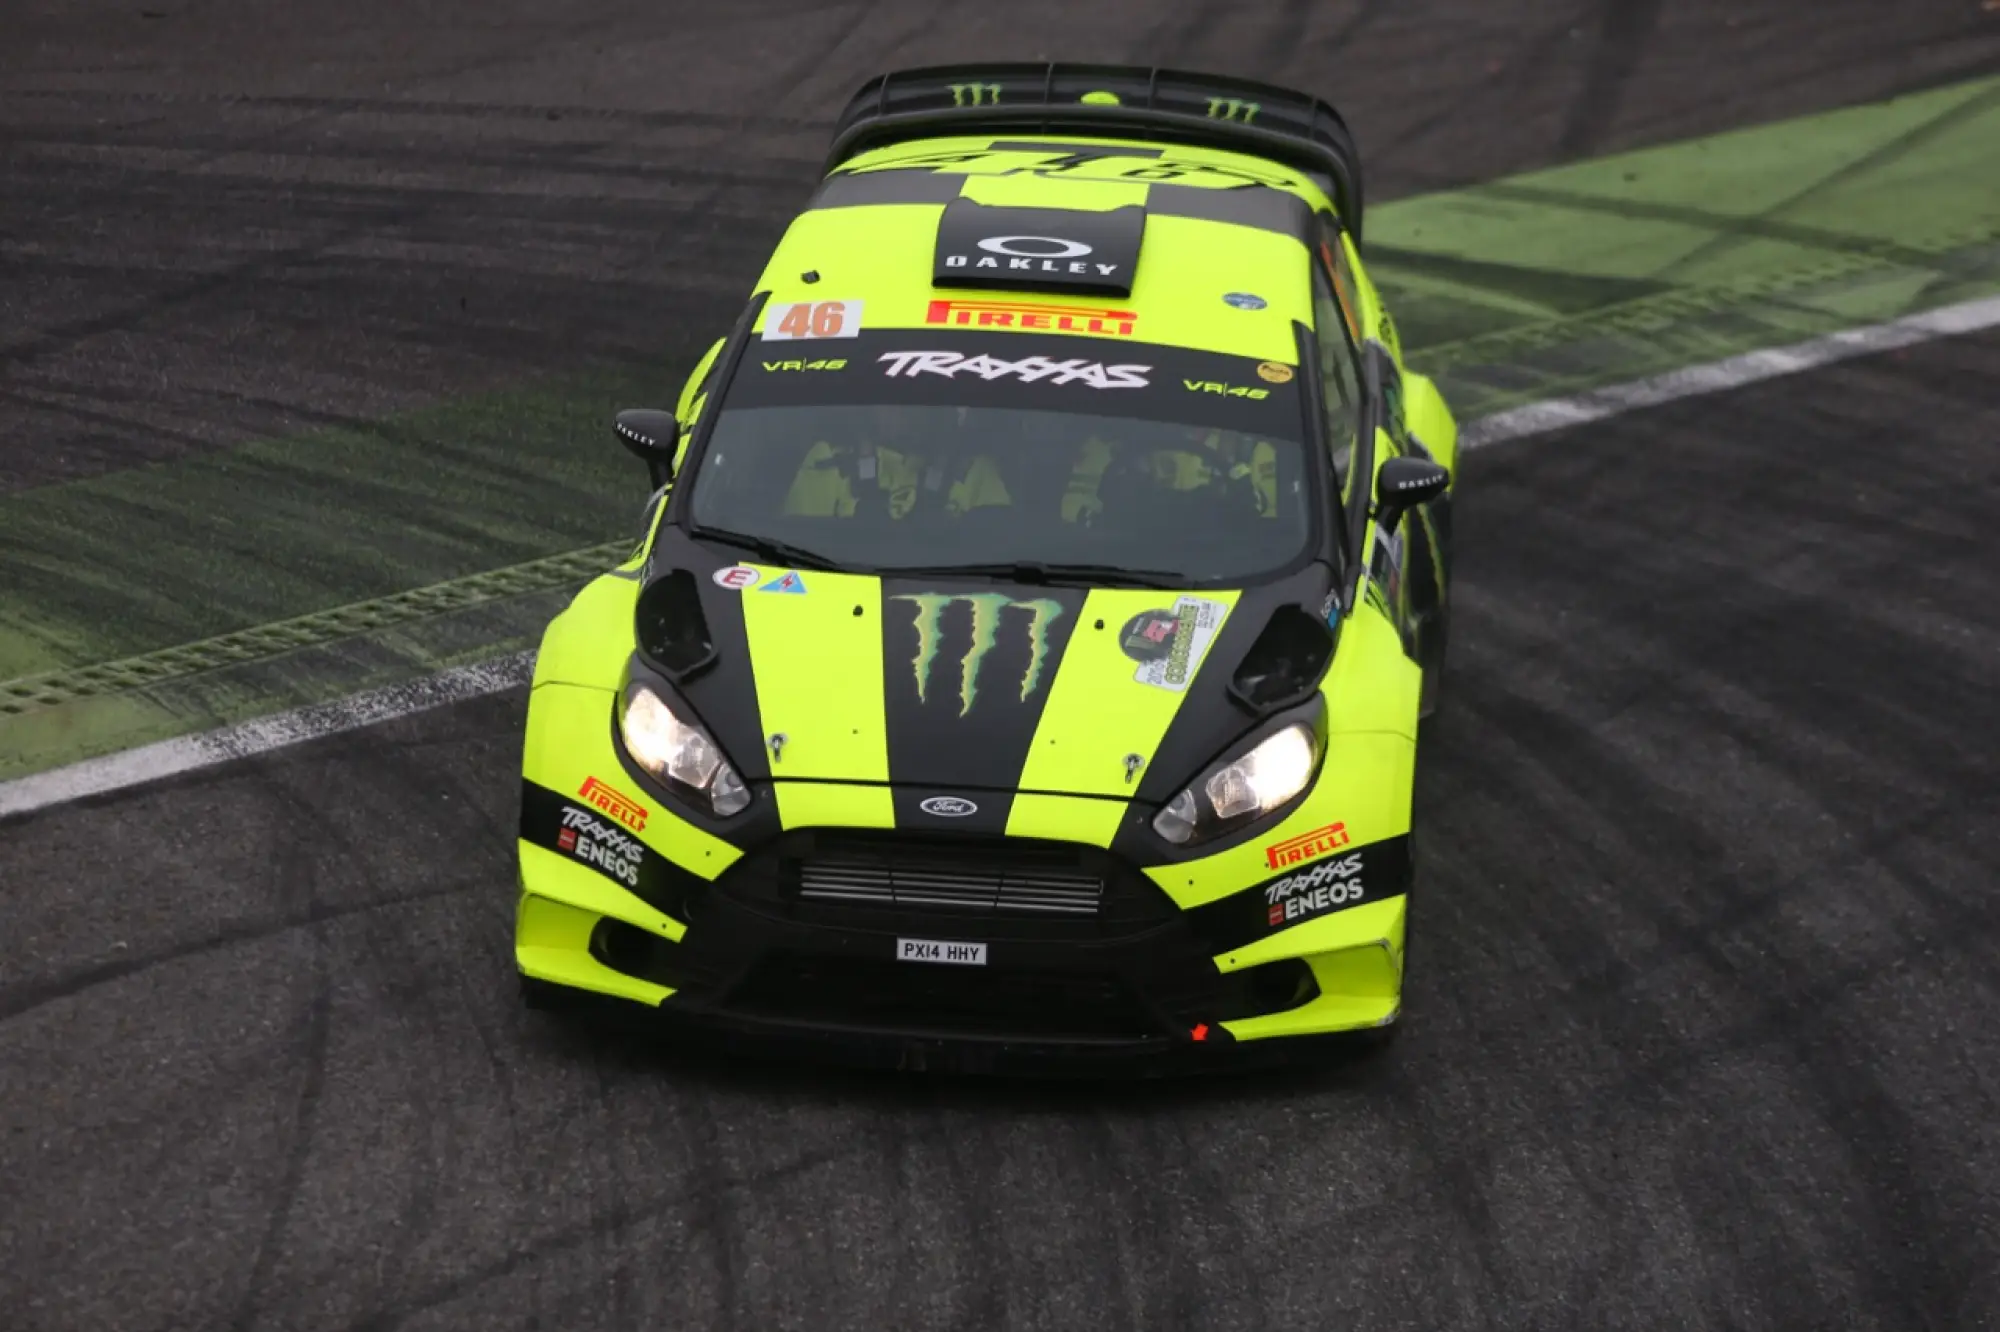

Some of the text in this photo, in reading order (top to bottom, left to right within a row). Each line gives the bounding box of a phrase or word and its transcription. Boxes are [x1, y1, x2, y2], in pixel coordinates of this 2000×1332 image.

[946, 255, 1119, 277] OAKLEY
[778, 301, 846, 338] 46
[926, 300, 1138, 336] PIRELLI
[877, 350, 1152, 389] TRAXXAS
[723, 570, 752, 585] E
[577, 776, 648, 832] PIRELLI
[932, 799, 965, 812] Ford
[561, 806, 644, 864] TRAXXAS
[1266, 822, 1349, 869] PIRELLI
[576, 836, 637, 886] ENEOS
[1265, 853, 1363, 904] TRAXXAS
[1286, 879, 1363, 919] ENEOS
[904, 943, 979, 961] PX14 HHY
